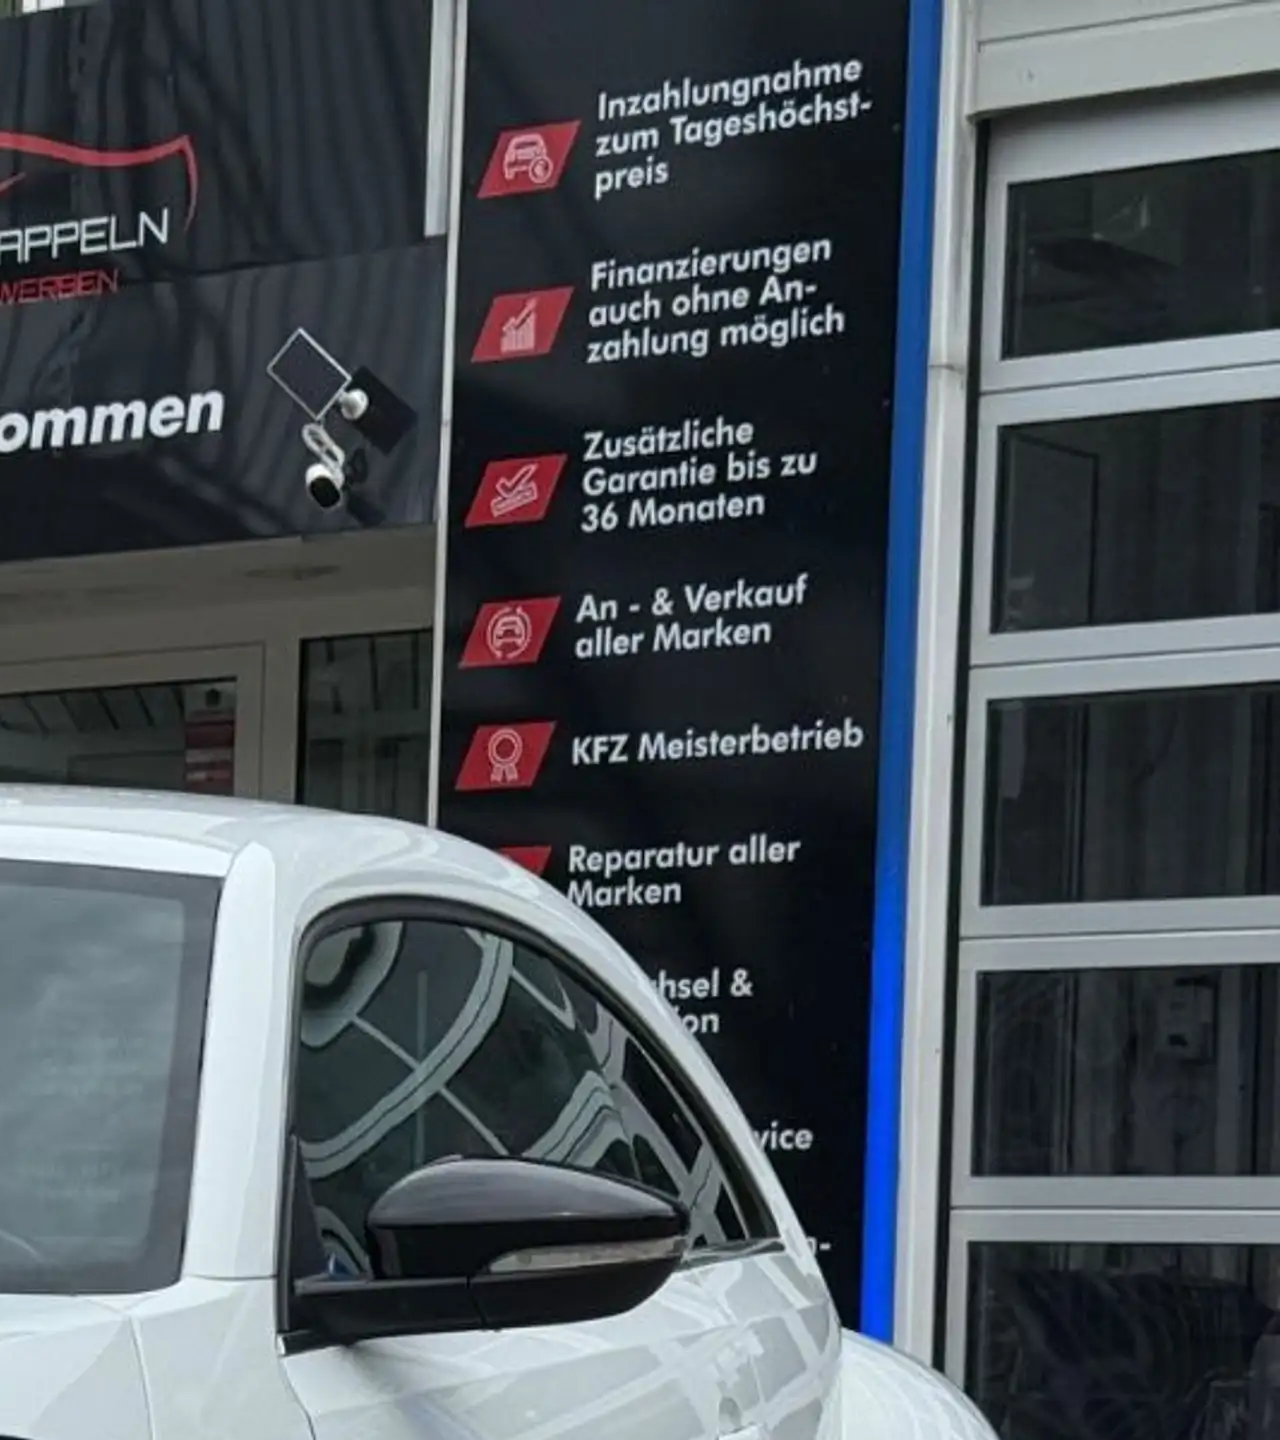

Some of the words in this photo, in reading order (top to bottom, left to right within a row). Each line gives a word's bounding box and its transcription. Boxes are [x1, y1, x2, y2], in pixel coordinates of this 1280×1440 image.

[598, 59, 863, 121] Inzahlungnahme
[595, 127, 660, 158] zum
[670, 91, 871, 148] Tageshöchst-
[595, 156, 669, 200] preis
[591, 239, 831, 292] Finanzierungen
[589, 290, 661, 328] auch
[672, 283, 750, 317] ohne
[759, 275, 816, 306] An-
[587, 324, 709, 364] zahlung
[720, 303, 845, 348] möglich
[583, 416, 754, 461] Zusätzliche
[583, 456, 716, 498] Garantie
[727, 449, 771, 482] bis
[780, 453, 817, 477] zu
[581, 501, 619, 533] 36
[629, 493, 765, 528] Monaten
[575, 594, 618, 623] An
[651, 587, 674, 616] &
[684, 573, 808, 613] Verkauf
[575, 626, 645, 659] aller
[652, 616, 771, 652] Marken
[572, 733, 629, 765] KFZ
[637, 717, 864, 761] Meisterbetrieb
[568, 842, 720, 879] Reparatur
[728, 833, 801, 865] aller
[566, 876, 682, 908] Marken
[730, 967, 754, 998] &
